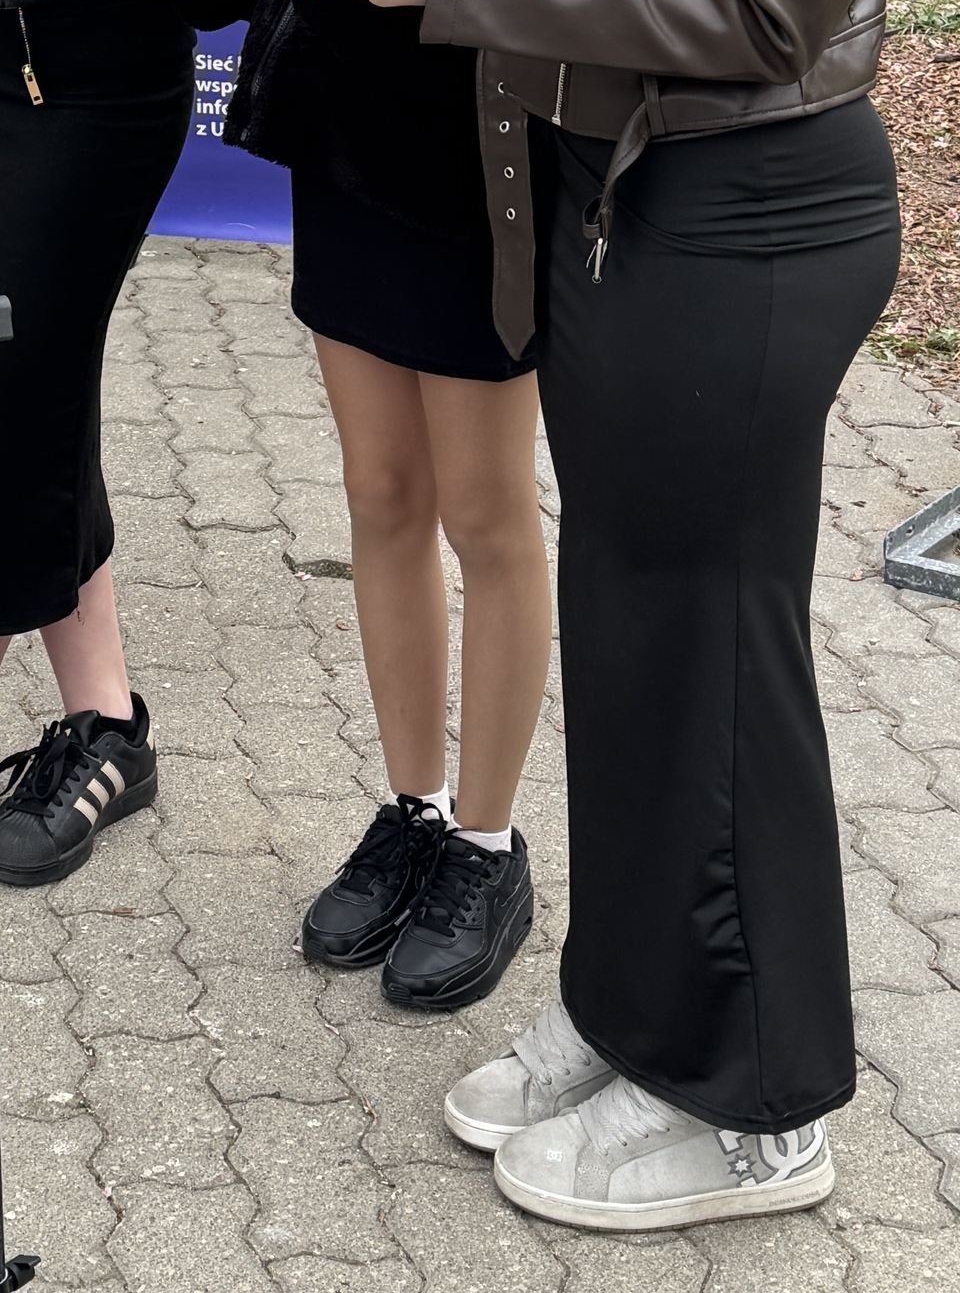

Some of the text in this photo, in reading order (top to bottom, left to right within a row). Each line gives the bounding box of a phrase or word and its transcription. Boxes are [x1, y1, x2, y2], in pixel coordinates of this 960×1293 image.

[195, 53, 234, 72] Sieć
[195, 79, 238, 97] wsp
[196, 124, 207, 136] z
